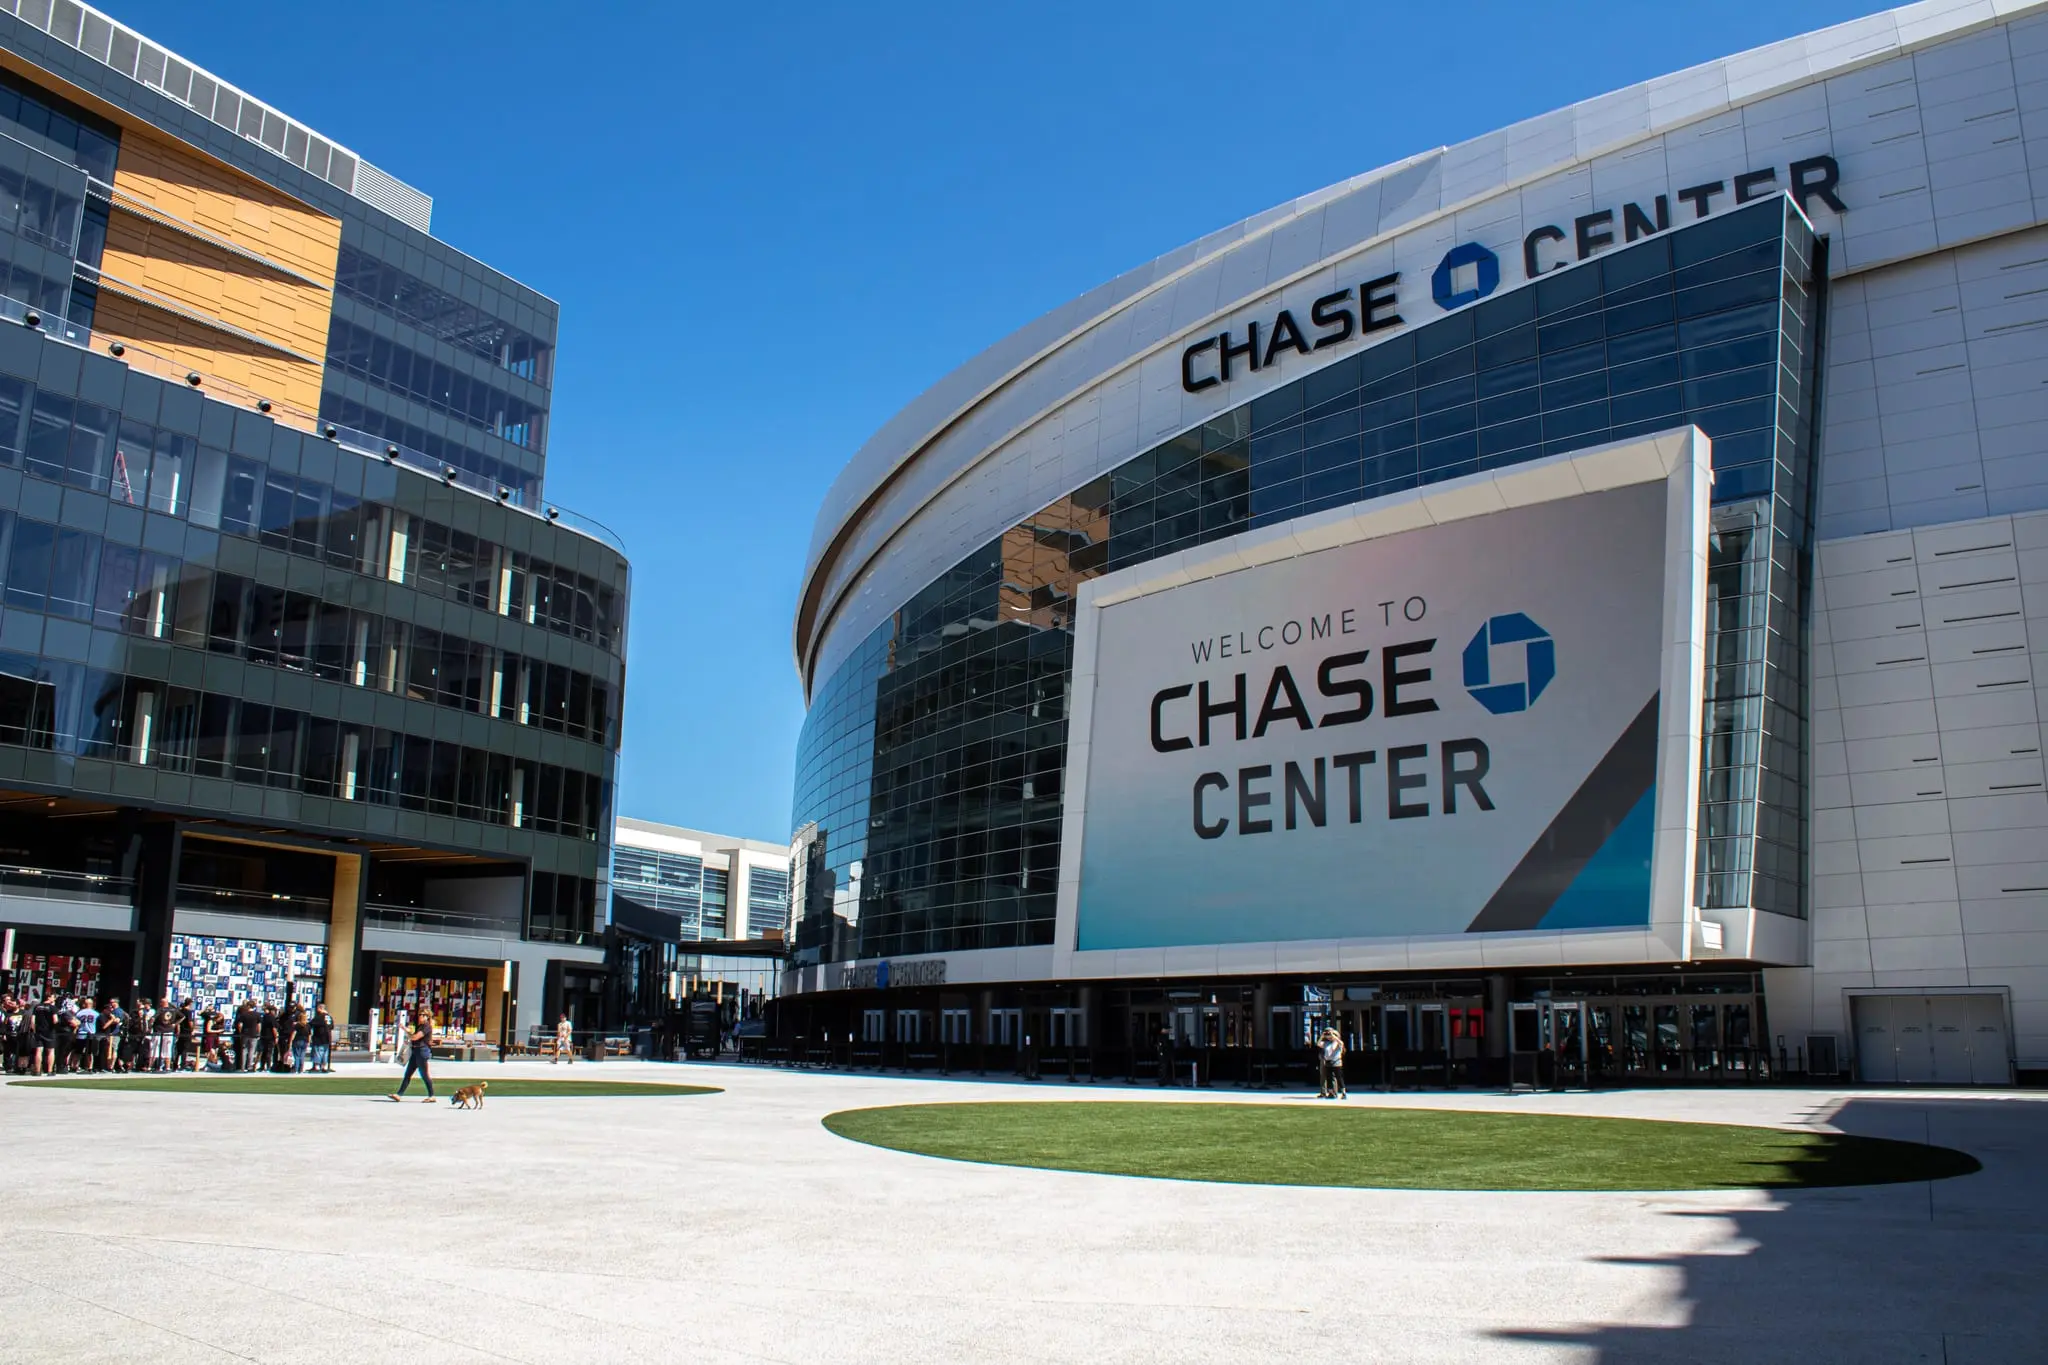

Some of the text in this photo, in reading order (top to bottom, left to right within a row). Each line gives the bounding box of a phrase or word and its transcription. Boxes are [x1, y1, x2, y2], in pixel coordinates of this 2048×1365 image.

[1181, 271, 1407, 393] CHASE
[1191, 595, 1427, 664] WELCOME TO
[1150, 637, 1440, 753] CHASE
[1193, 737, 1496, 840] CENTER
